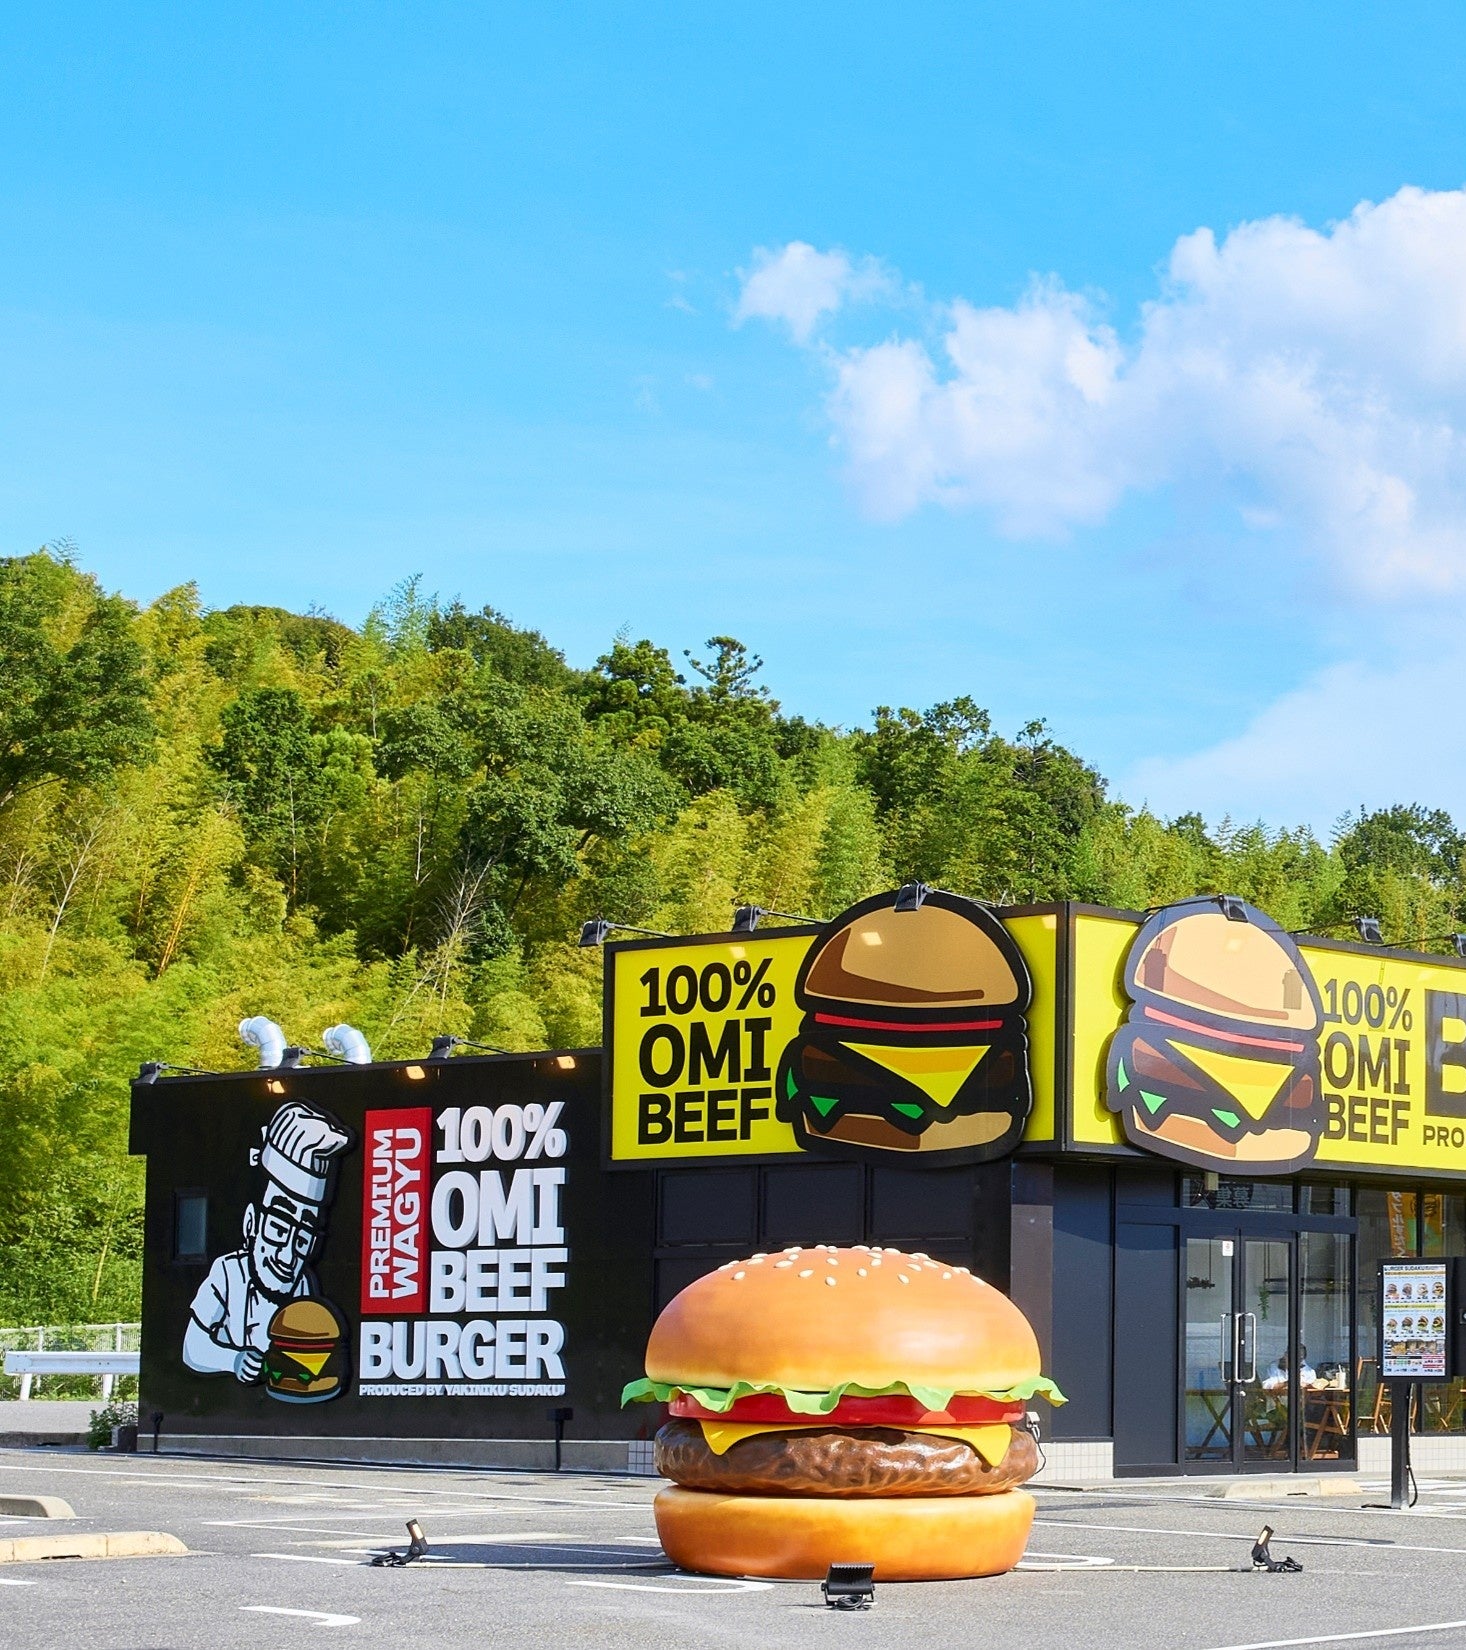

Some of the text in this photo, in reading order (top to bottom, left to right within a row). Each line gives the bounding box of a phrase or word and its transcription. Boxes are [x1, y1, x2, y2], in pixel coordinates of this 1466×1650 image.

[639, 958, 776, 1018] 100%
[1324, 978, 1413, 1032] 100%
[639, 1017, 772, 1088] OMI
[1324, 1031, 1411, 1095] OMI
[435, 1101, 567, 1163] 100%
[637, 1087, 772, 1145] BEEF
[1323, 1093, 1411, 1145] BEEF
[369, 1128, 393, 1298] PREMIUM
[392, 1127, 422, 1300] WAGYU
[430, 1167, 566, 1249] OMI
[429, 1248, 568, 1313] BEEF
[359, 1319, 566, 1380] BURGER
[359, 1384, 566, 1396] PRODUCED BY YAKINIKU SUDAKU
